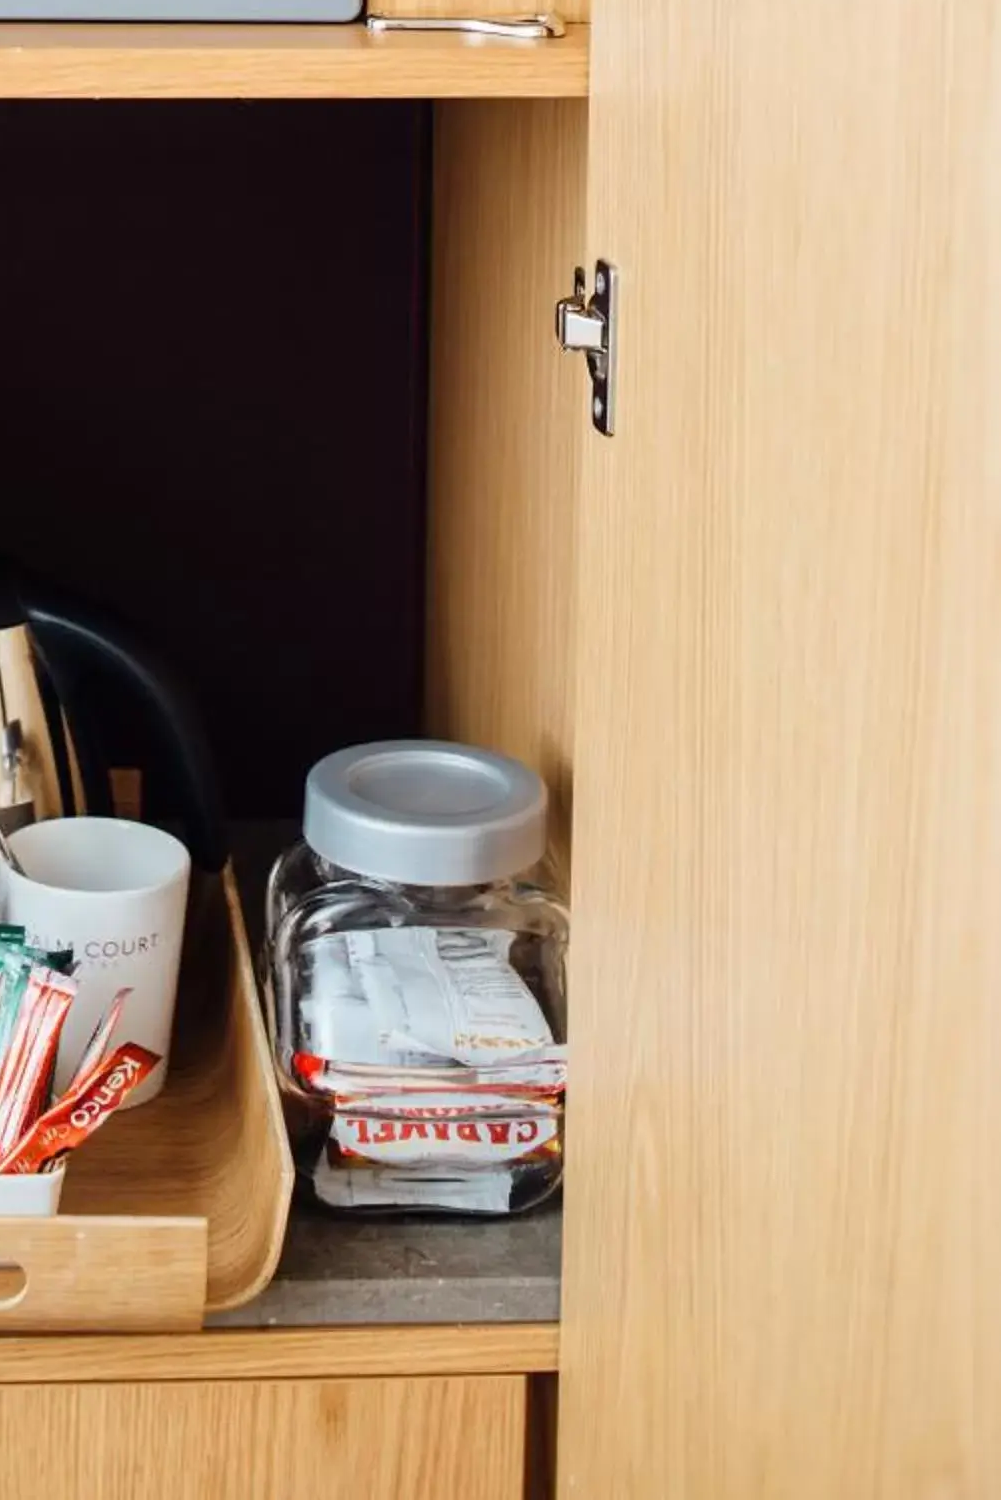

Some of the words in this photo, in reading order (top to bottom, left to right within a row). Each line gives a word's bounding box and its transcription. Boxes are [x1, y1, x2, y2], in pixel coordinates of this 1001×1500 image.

[84, 933, 159, 959] COURT
[70, 1056, 142, 1128] Kenco
[346, 1119, 539, 1145] CARAMEL
